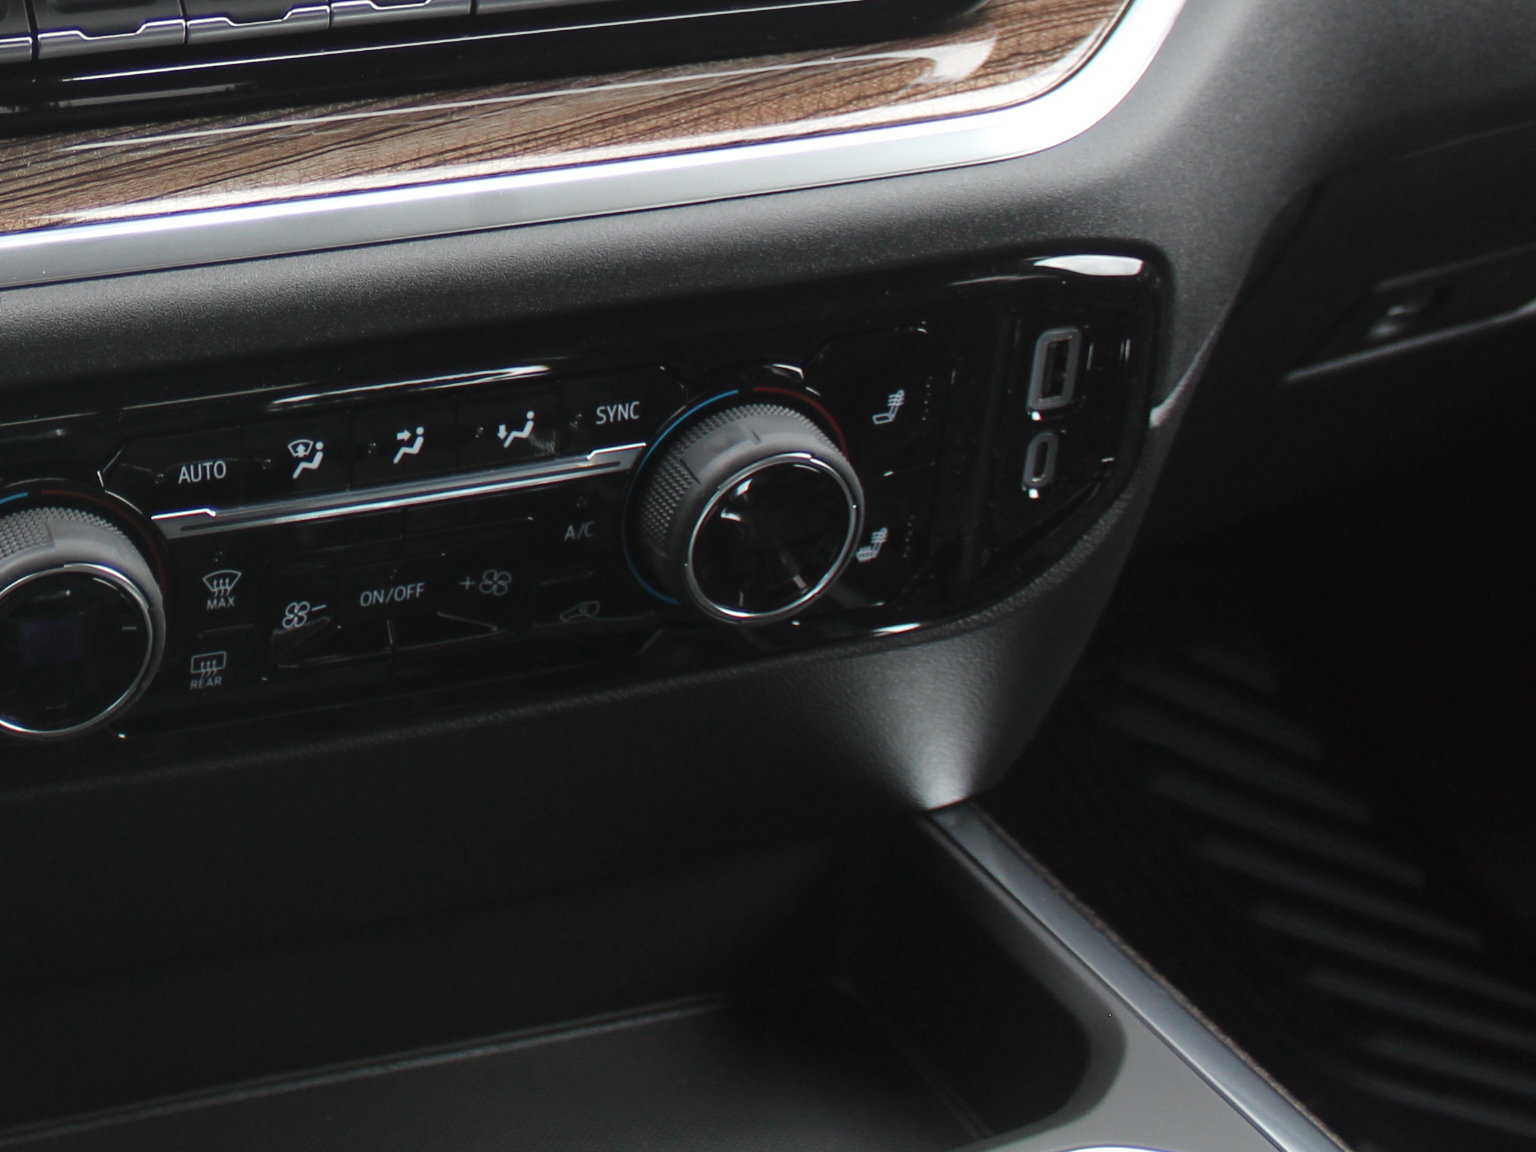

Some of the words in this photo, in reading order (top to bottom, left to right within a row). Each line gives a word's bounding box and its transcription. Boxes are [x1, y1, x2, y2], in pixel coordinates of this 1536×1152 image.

[595, 401, 640, 425] SYNC
[178, 460, 226, 484] AUTO
[564, 521, 595, 541] A/C
[206, 597, 235, 611] MAX
[359, 582, 426, 607] ON/OFF
[190, 675, 222, 690] REAR
